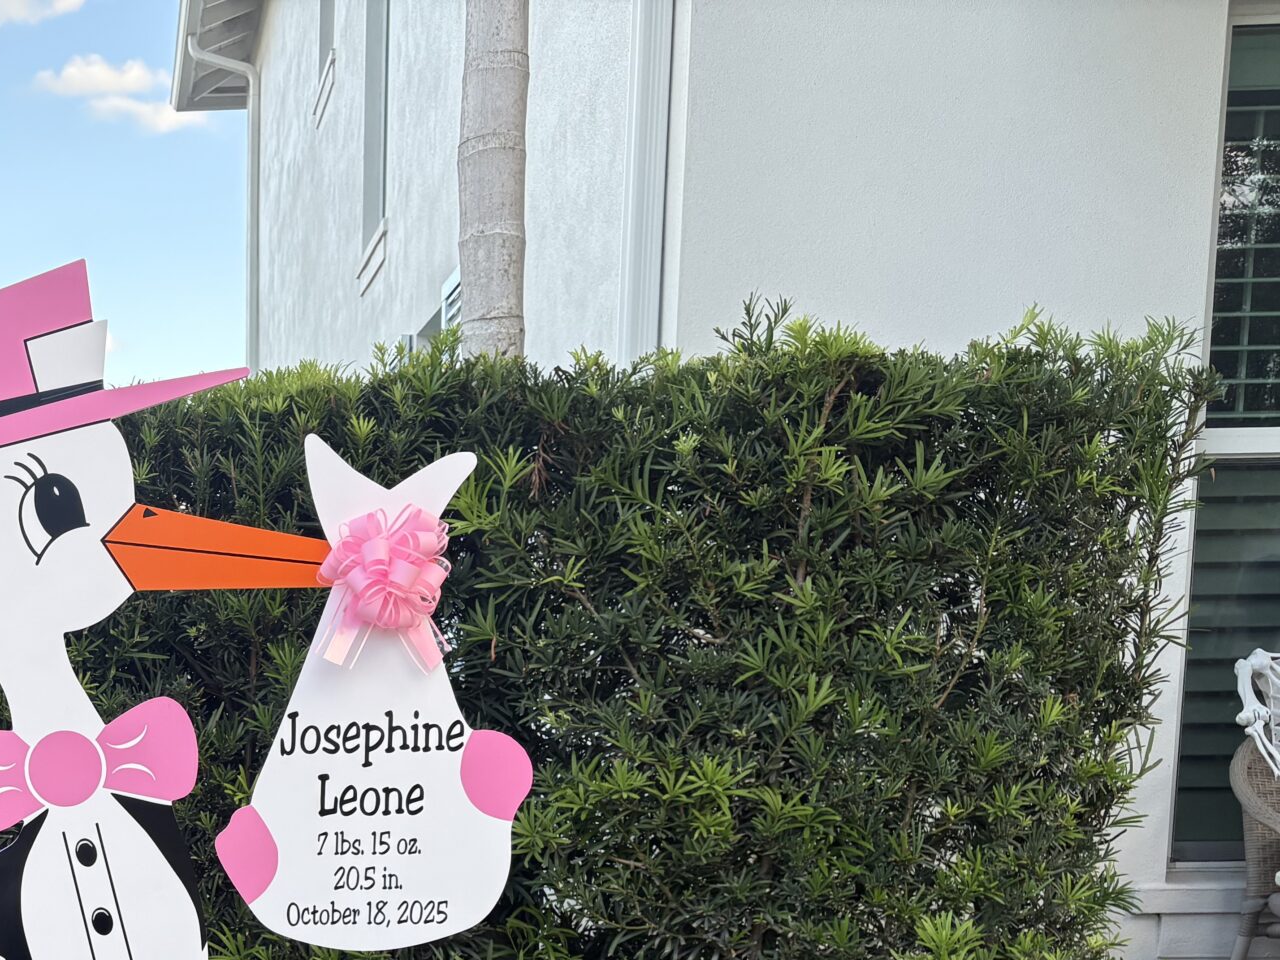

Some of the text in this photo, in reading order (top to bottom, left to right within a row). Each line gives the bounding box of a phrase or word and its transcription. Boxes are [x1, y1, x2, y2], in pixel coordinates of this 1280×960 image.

[280, 710, 465, 768] Josephine
[317, 773, 425, 817] Leone
[317, 831, 422, 856] 7 lbs. 15 oz.
[333, 866, 403, 891] 20.5 in.
[286, 900, 448, 928] October 18, 2025
